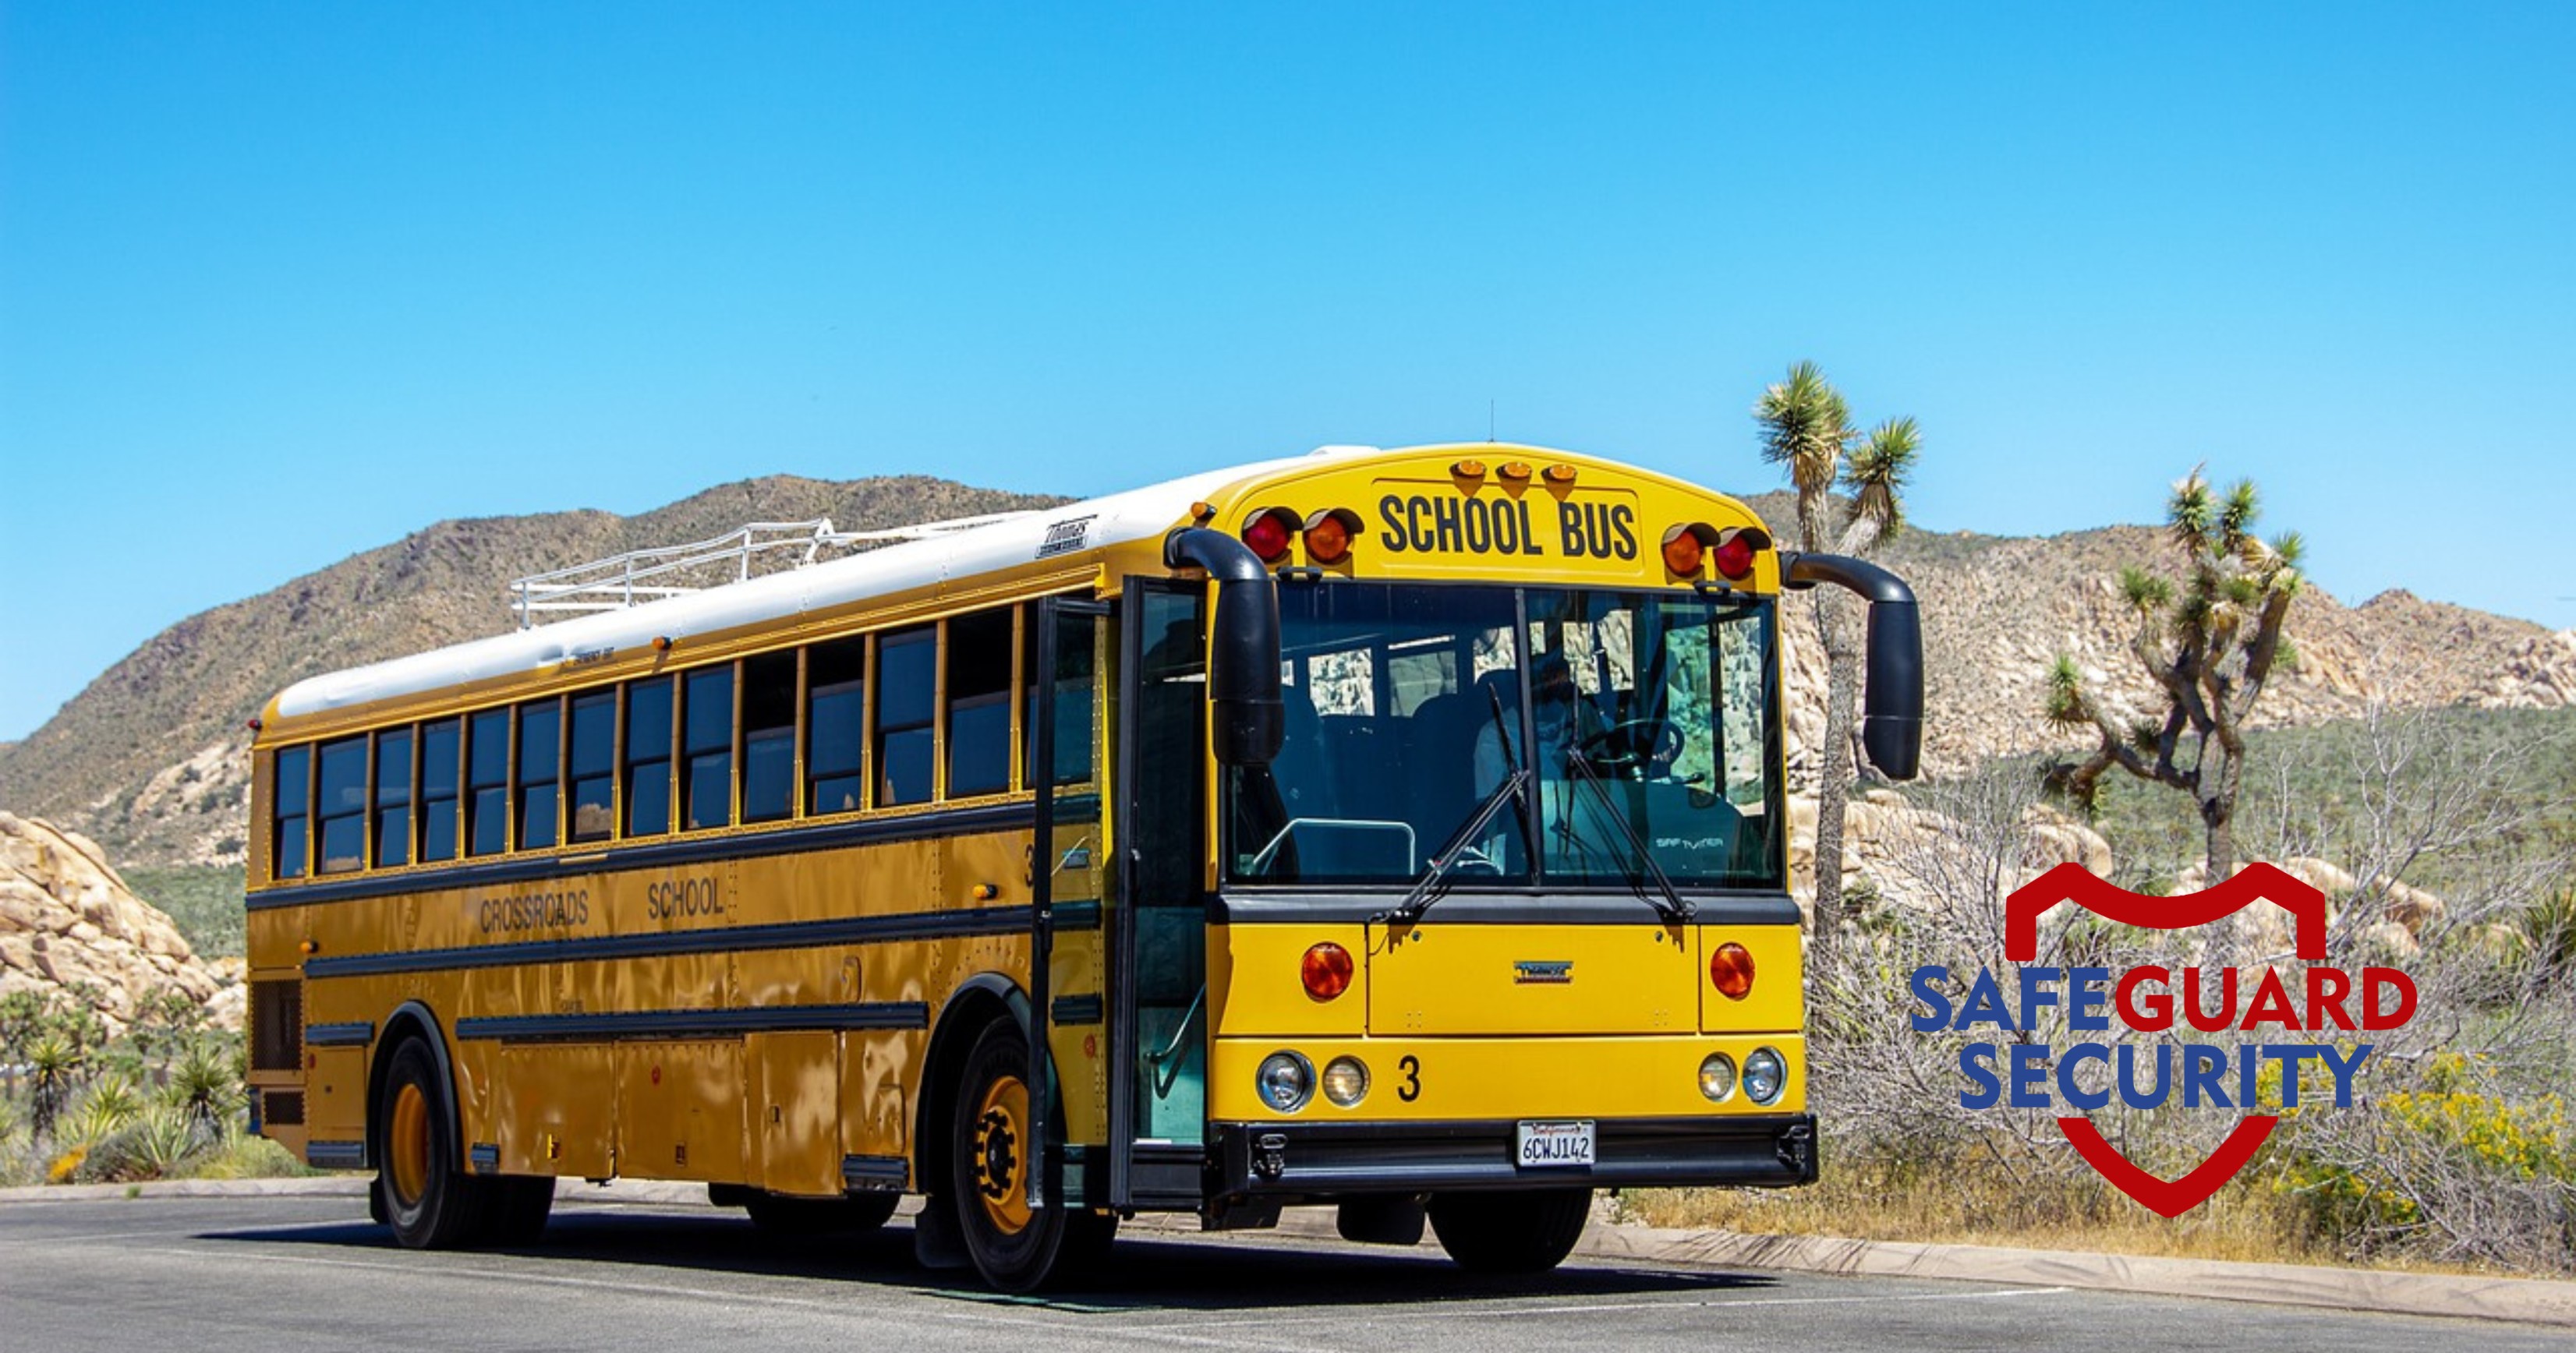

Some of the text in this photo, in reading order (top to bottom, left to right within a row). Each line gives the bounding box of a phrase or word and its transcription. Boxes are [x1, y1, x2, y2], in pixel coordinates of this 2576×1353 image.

[1380, 494, 1637, 561] SCHOOL BUS
[481, 878, 724, 933] CROSSROADS SCHOOL
[1397, 1054, 1421, 1102] 3
[1523, 1137, 1589, 1160] 6CWJ142
